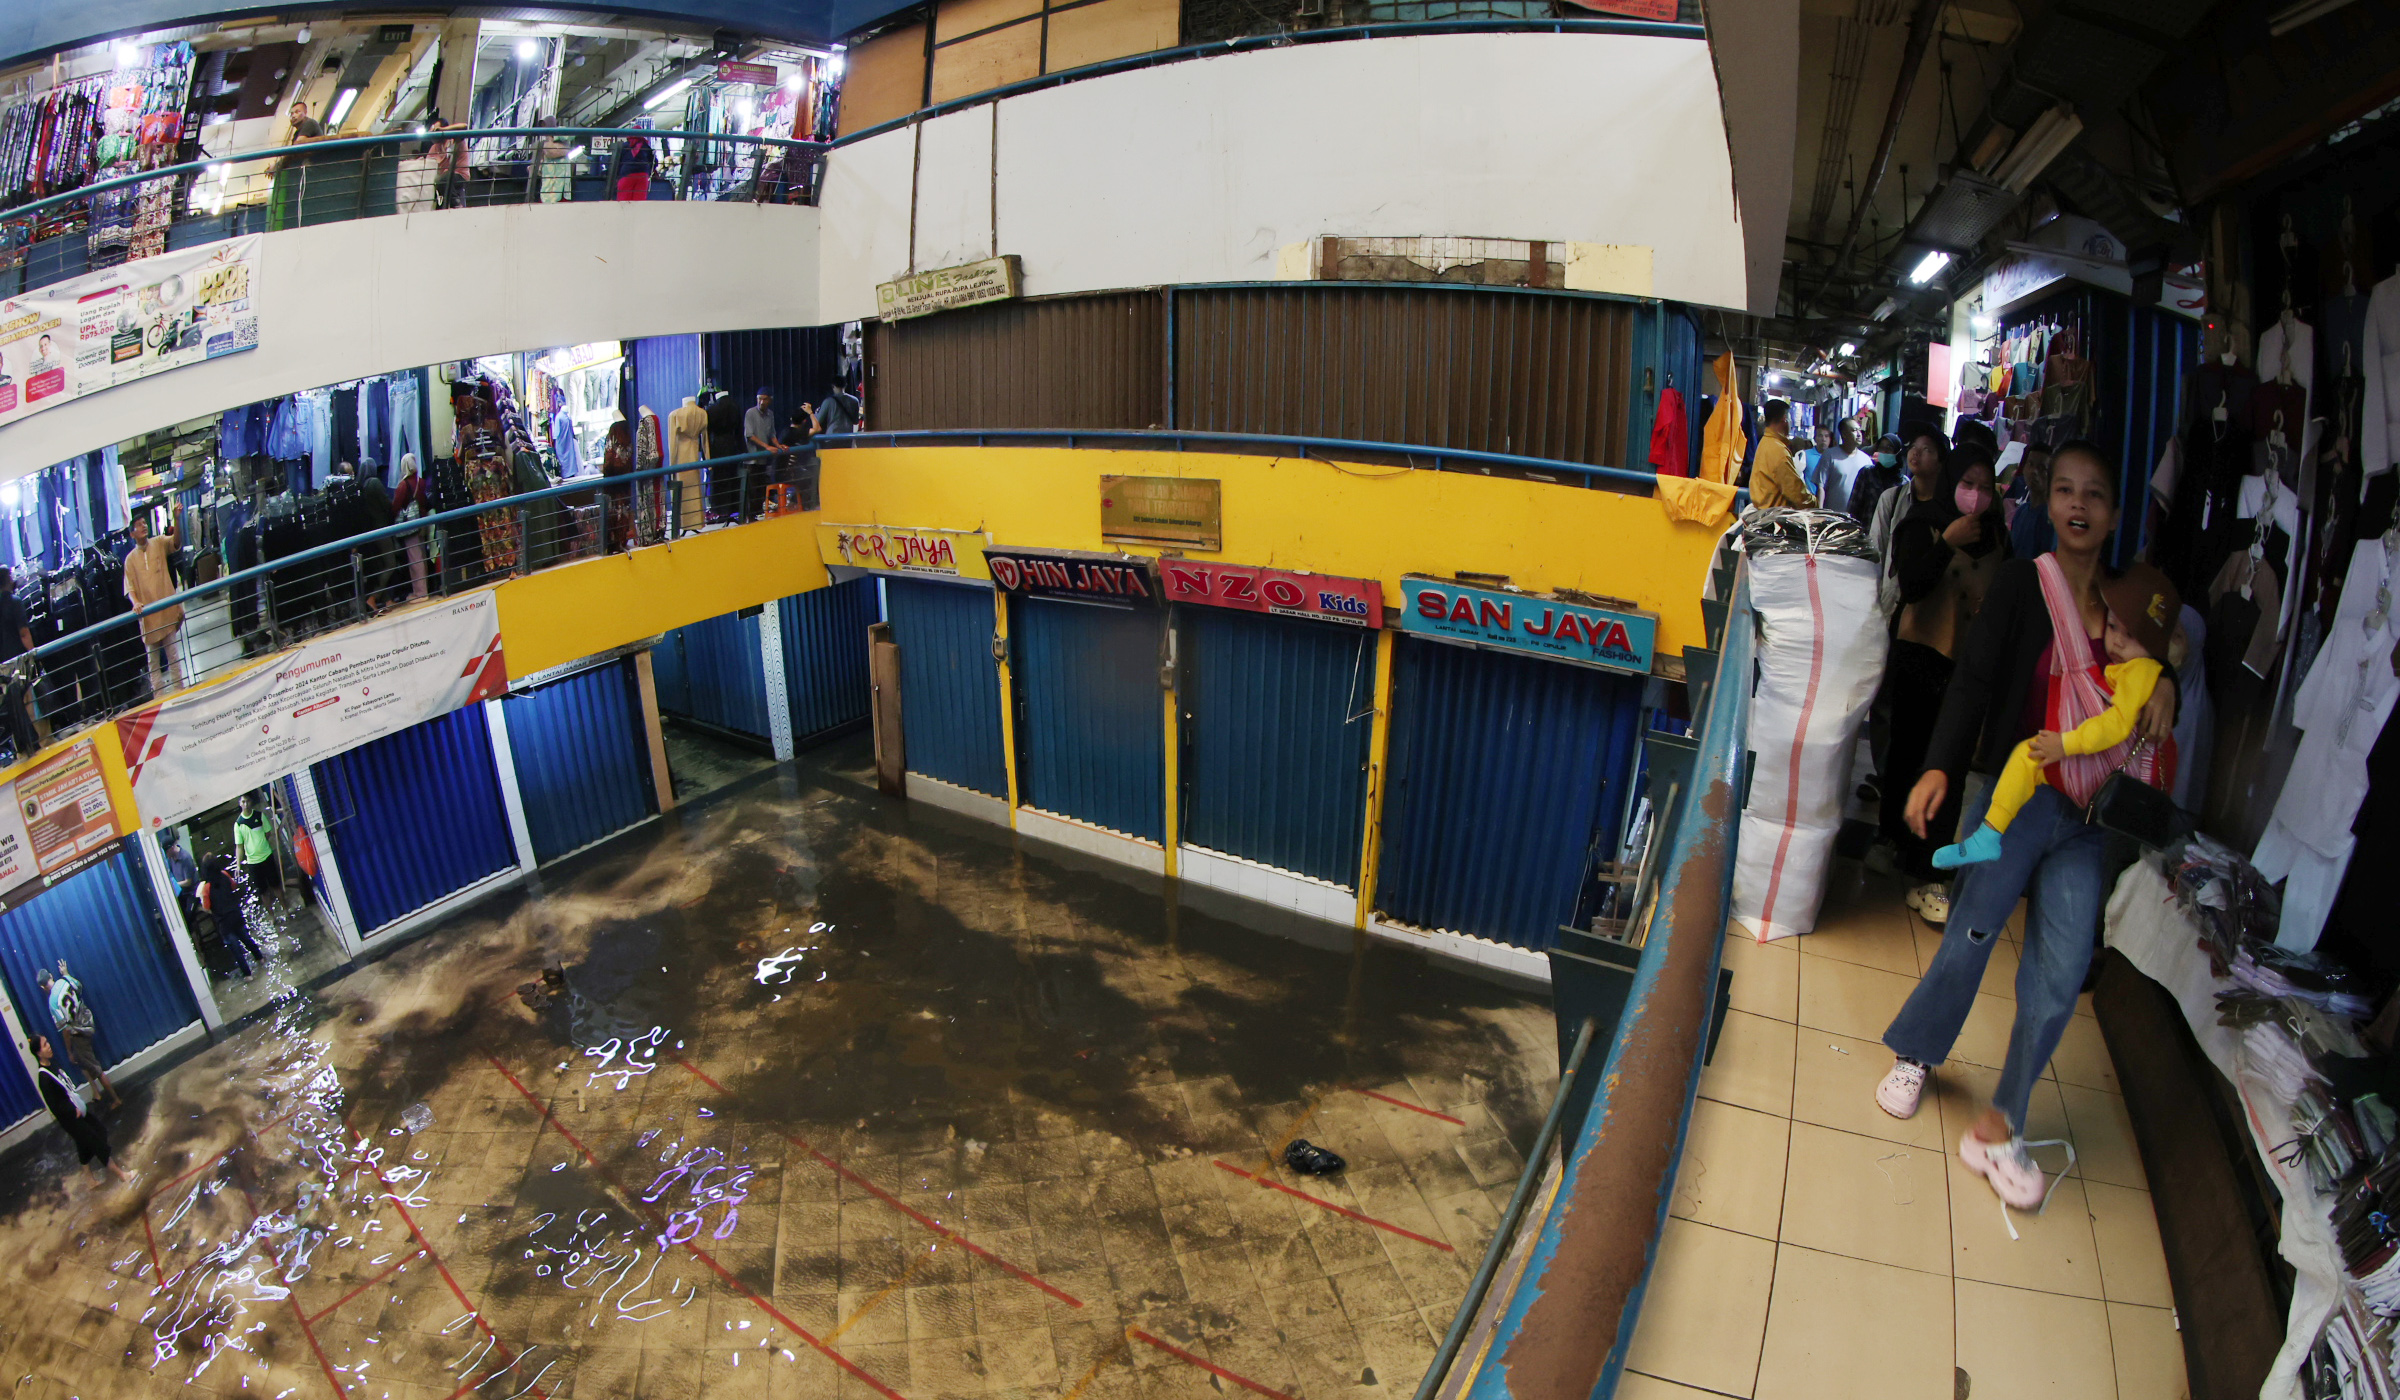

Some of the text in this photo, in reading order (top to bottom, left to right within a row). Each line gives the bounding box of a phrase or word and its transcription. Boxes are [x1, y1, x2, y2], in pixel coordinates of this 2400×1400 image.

[385, 32, 406, 41] EXIT
[200, 264, 249, 290] DOOR
[200, 282, 248, 308] PRIZE
[80, 313, 102, 324] Logam
[81, 301, 121, 318] Uang Rupiah
[80, 323, 97, 334] UPK
[80, 325, 115, 341] Rp75.000
[155, 464, 169, 473] EXIT
[853, 533, 956, 568] CR JAYA
[1018, 559, 1073, 589] HIN
[1077, 564, 1149, 597] JAYA
[452, 600, 488, 616] BANK DKI
[1318, 590, 1368, 615] Kids
[1417, 589, 1634, 652] SAN JAYA
[1542, 642, 1567, 651] CIPULIR
[1592, 647, 1642, 664] FASHION
[275, 652, 342, 683] Pengumuman
[537, 661, 587, 680] LANTAI DASAR
[191, 716, 215, 731] Terhitung
[216, 709, 233, 722] Efektif
[232, 706, 243, 716] Per
[243, 697, 263, 712] Tanggal
[267, 687, 294, 701] Desember
[295, 680, 309, 690] 2024
[309, 674, 328, 685] Kantor
[328, 665, 349, 678] Cabang
[349, 657, 376, 670] Pembantu
[376, 651, 391, 661] Pasar
[391, 645, 409, 657] Cipulir
[235, 711, 252, 722] Terima
[252, 704, 268, 715] Kasih
[267, 699, 281, 709] Atas
[280, 687, 312, 704] Kepercayaan
[312, 681, 332, 692] Seluruh
[333, 671, 356, 684] Nasabah
[360, 666, 374, 676] Mitra
[374, 659, 391, 670] Usaha
[181, 740, 198, 752] Untuk
[198, 725, 235, 745] Mempermudah
[235, 718, 258, 732] Layanan
[257, 709, 277, 722] Kepada
[301, 694, 316, 704] Maka
[315, 685, 338, 699] Kegiatan
[338, 678, 362, 691] Transaksi
[362, 672, 378, 683] Serta
[377, 666, 399, 678] Layanan
[399, 660, 415, 671] Dapat
[415, 651, 440, 664] Dilakukan
[350, 703, 362, 713] Pasar
[362, 696, 384, 709] Kebayoran
[383, 691, 395, 701] Lama
[373, 701, 387, 711] Jakarta
[386, 696, 402, 707] Selatan
[258, 734, 281, 747] KCP Cipulir
[234, 760, 256, 772] Kebayoran
[255, 755, 266, 765] Lama
[269, 749, 283, 760] Jakarta
[250, 748, 266, 759] Ciledug
[265, 744, 276, 753] Raya
[39, 789, 58, 801] STMIK
[57, 775, 84, 793] JAKARTA
[0, 834, 15, 847] WIB
